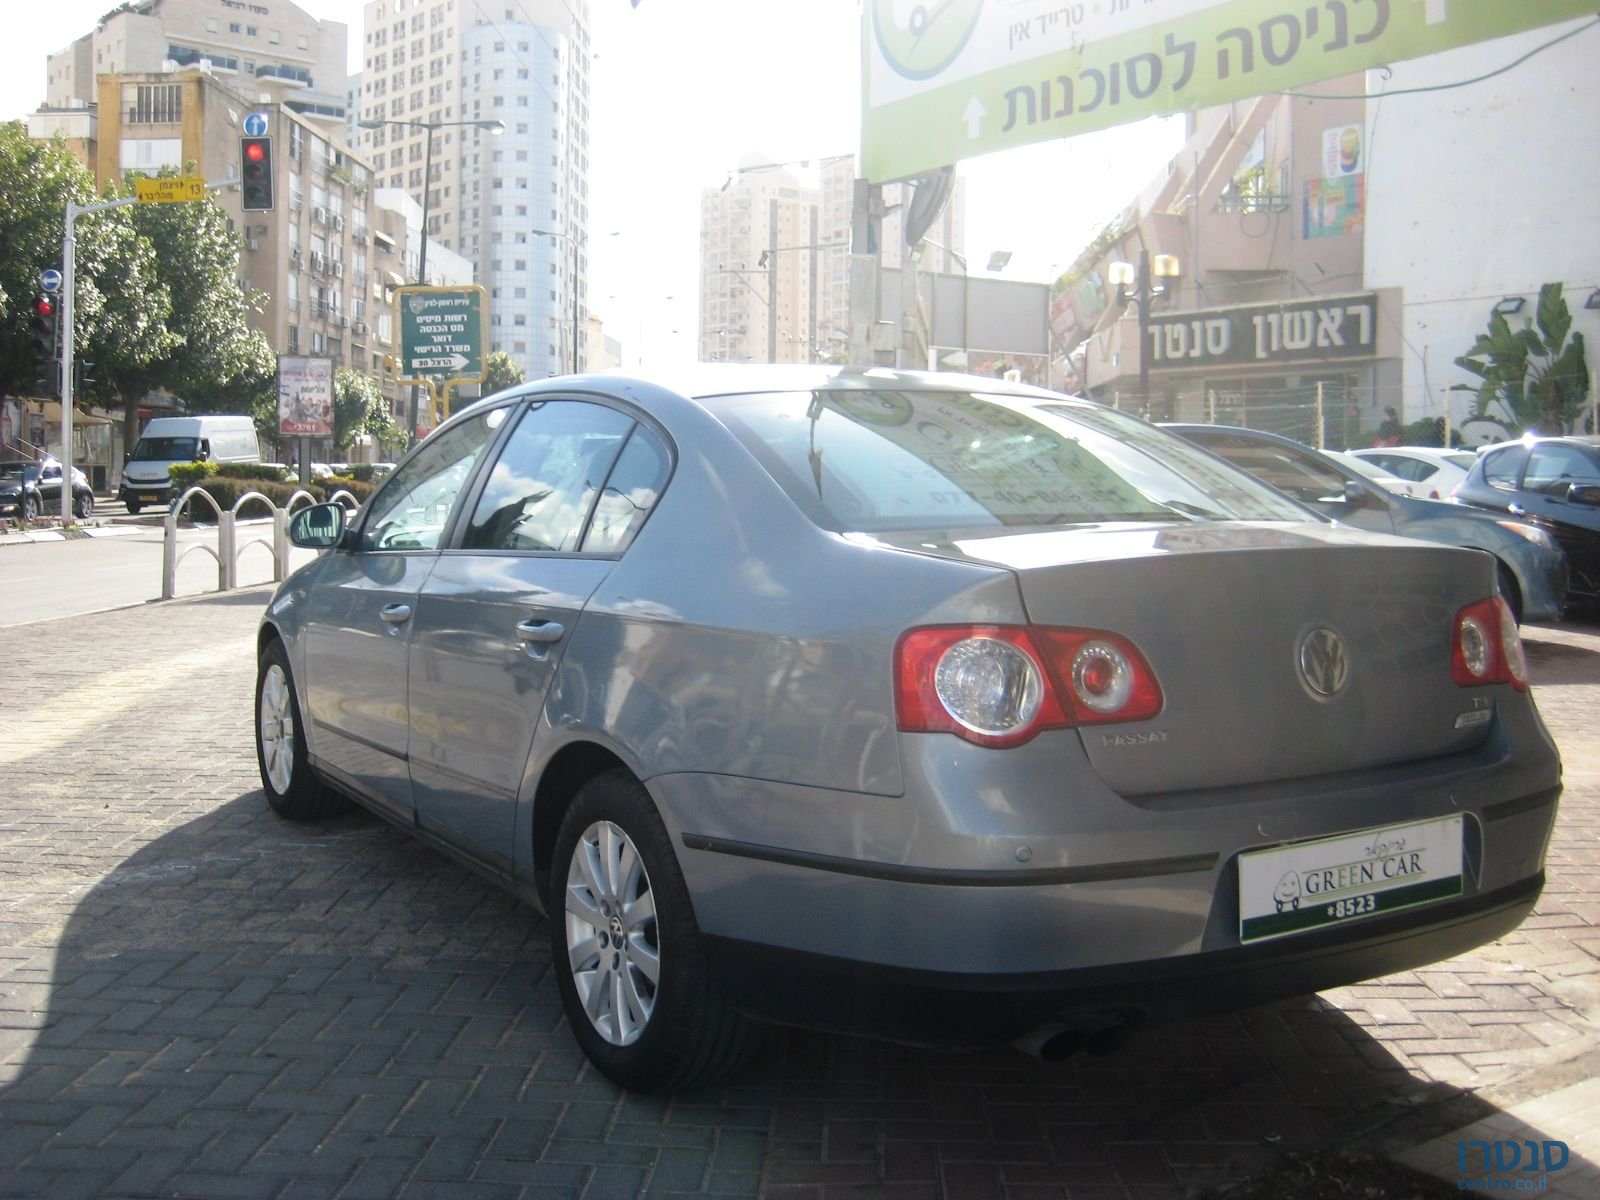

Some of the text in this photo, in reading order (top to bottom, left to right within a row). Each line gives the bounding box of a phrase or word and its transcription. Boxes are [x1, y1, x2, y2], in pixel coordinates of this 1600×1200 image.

[1036, 3, 1085, 36] טרייד
[1008, 19, 1032, 51] אין
[1002, 0, 1391, 133] כניסה לסוכנות
[190, 184, 201, 195] 13
[416, 314, 468, 324] רשות מיסים
[420, 324, 464, 334] מס הכנסה
[1147, 304, 1371, 361] ראשון סנטר
[431, 334, 453, 344] דואר
[444, 344, 471, 353] משרד
[1102, 729, 1168, 747] PASSAT
[1305, 852, 1422, 894] GREEN CAR
